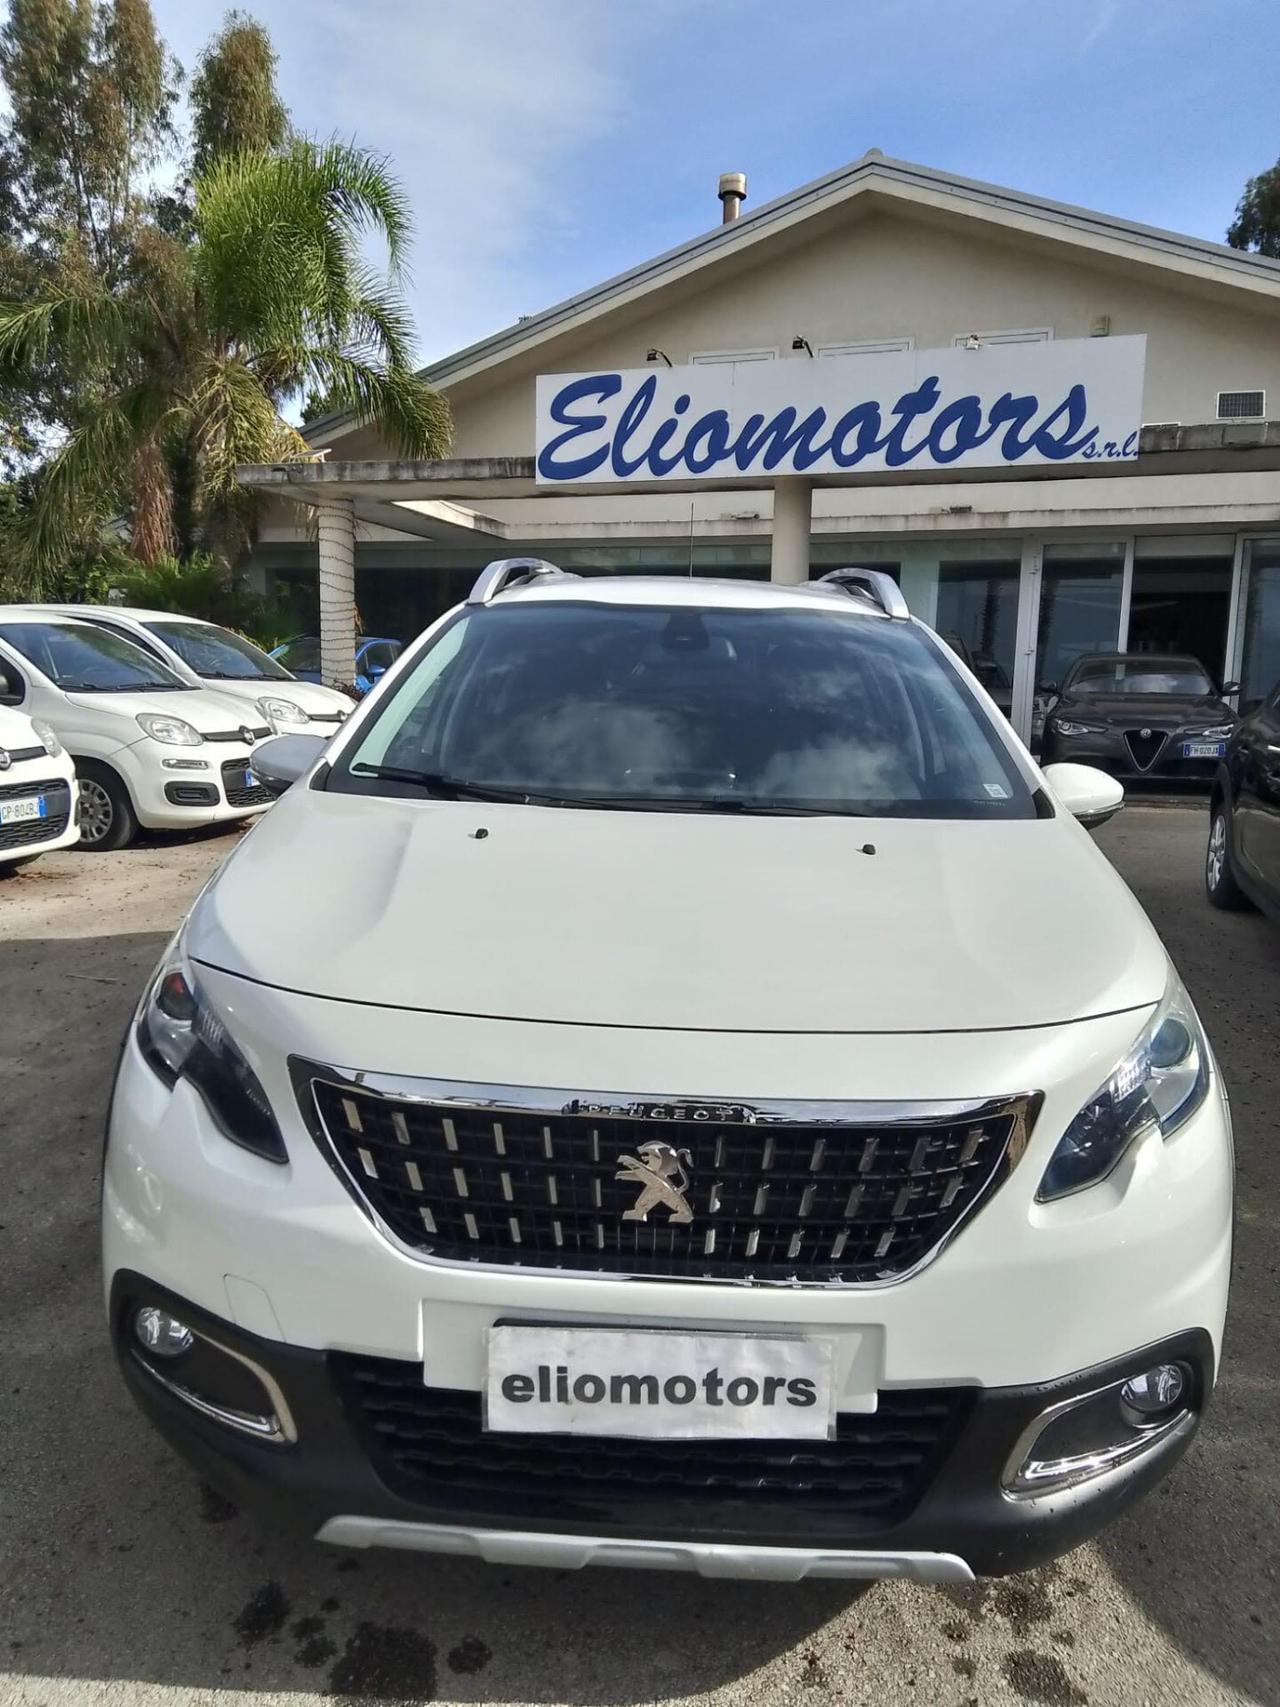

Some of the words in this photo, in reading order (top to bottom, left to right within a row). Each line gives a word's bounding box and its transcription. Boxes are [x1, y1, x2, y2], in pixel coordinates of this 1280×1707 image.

[538, 373, 1099, 480] Eliomotors
[1082, 431, 1138, 458] s.r.l.
[588, 1103, 734, 1121] PEUGEOT
[501, 1365, 817, 1407] eliomotors
